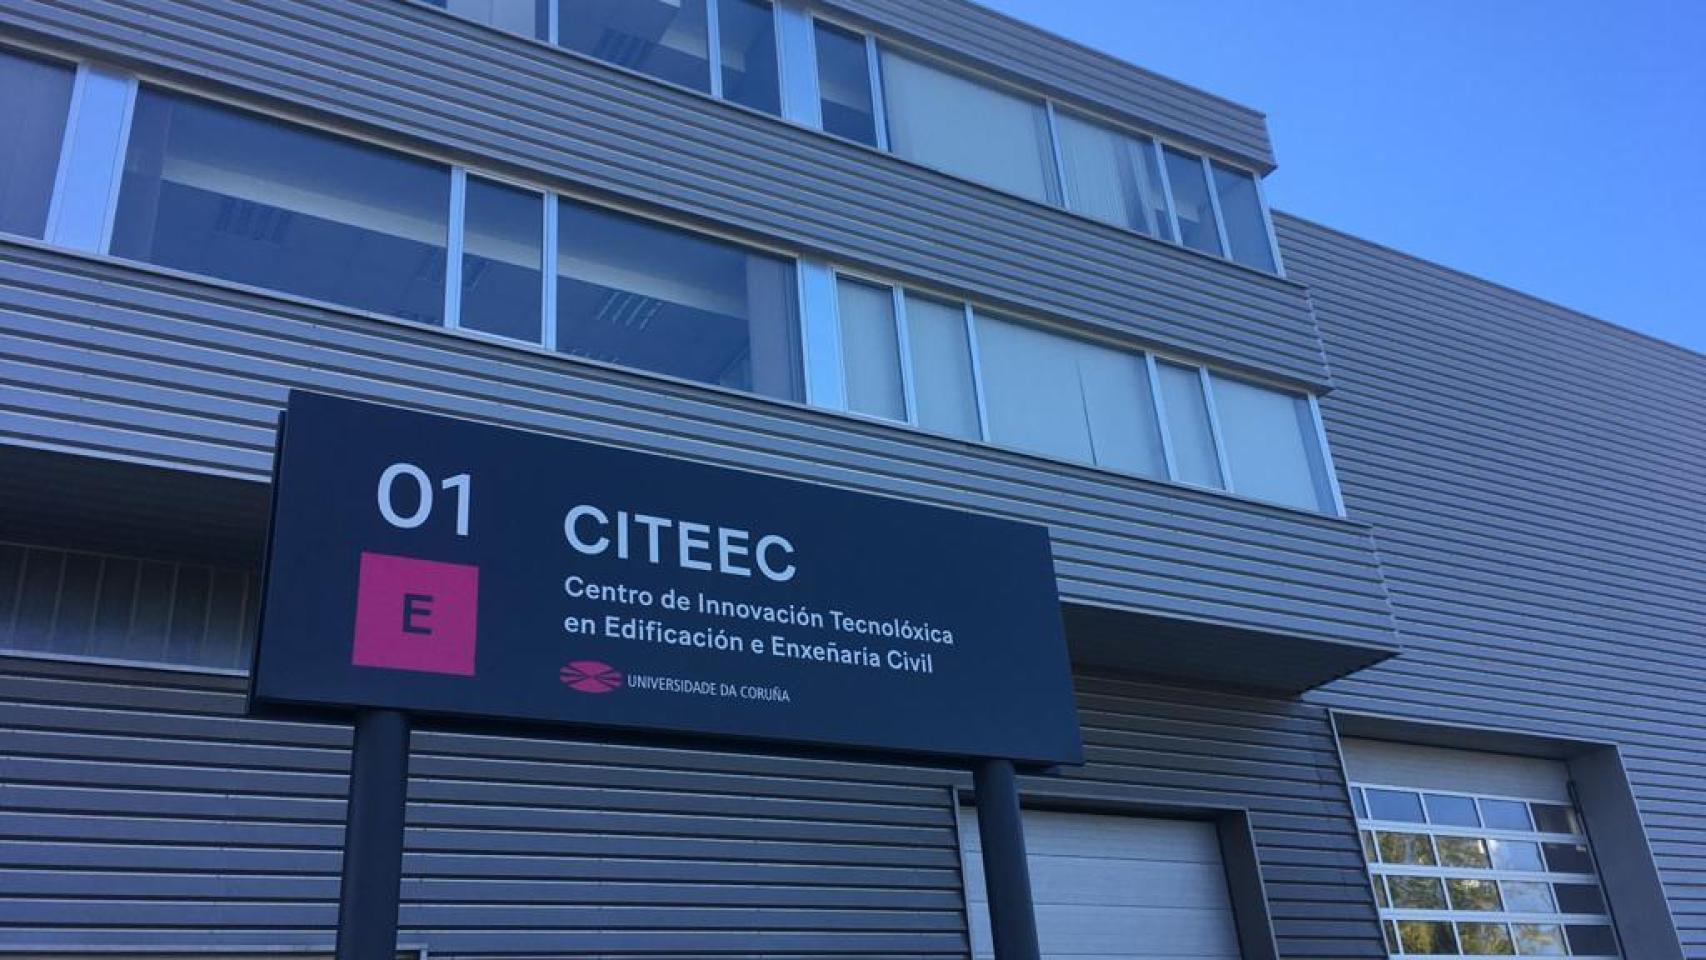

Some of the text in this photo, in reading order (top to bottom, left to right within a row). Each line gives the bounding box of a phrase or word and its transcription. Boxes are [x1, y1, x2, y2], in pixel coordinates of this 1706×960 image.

[377, 462, 471, 536] 01
[564, 504, 796, 582] CITEEC
[402, 593, 433, 634] E
[564, 575, 955, 645] Centro de Innovación Tecnolóxica
[564, 616, 596, 635] en
[605, 615, 744, 652] Edificación
[750, 639, 764, 654] e
[887, 649, 933, 673] Civil
[627, 675, 791, 702] UNIVERSIDADE DA CORUÑA
